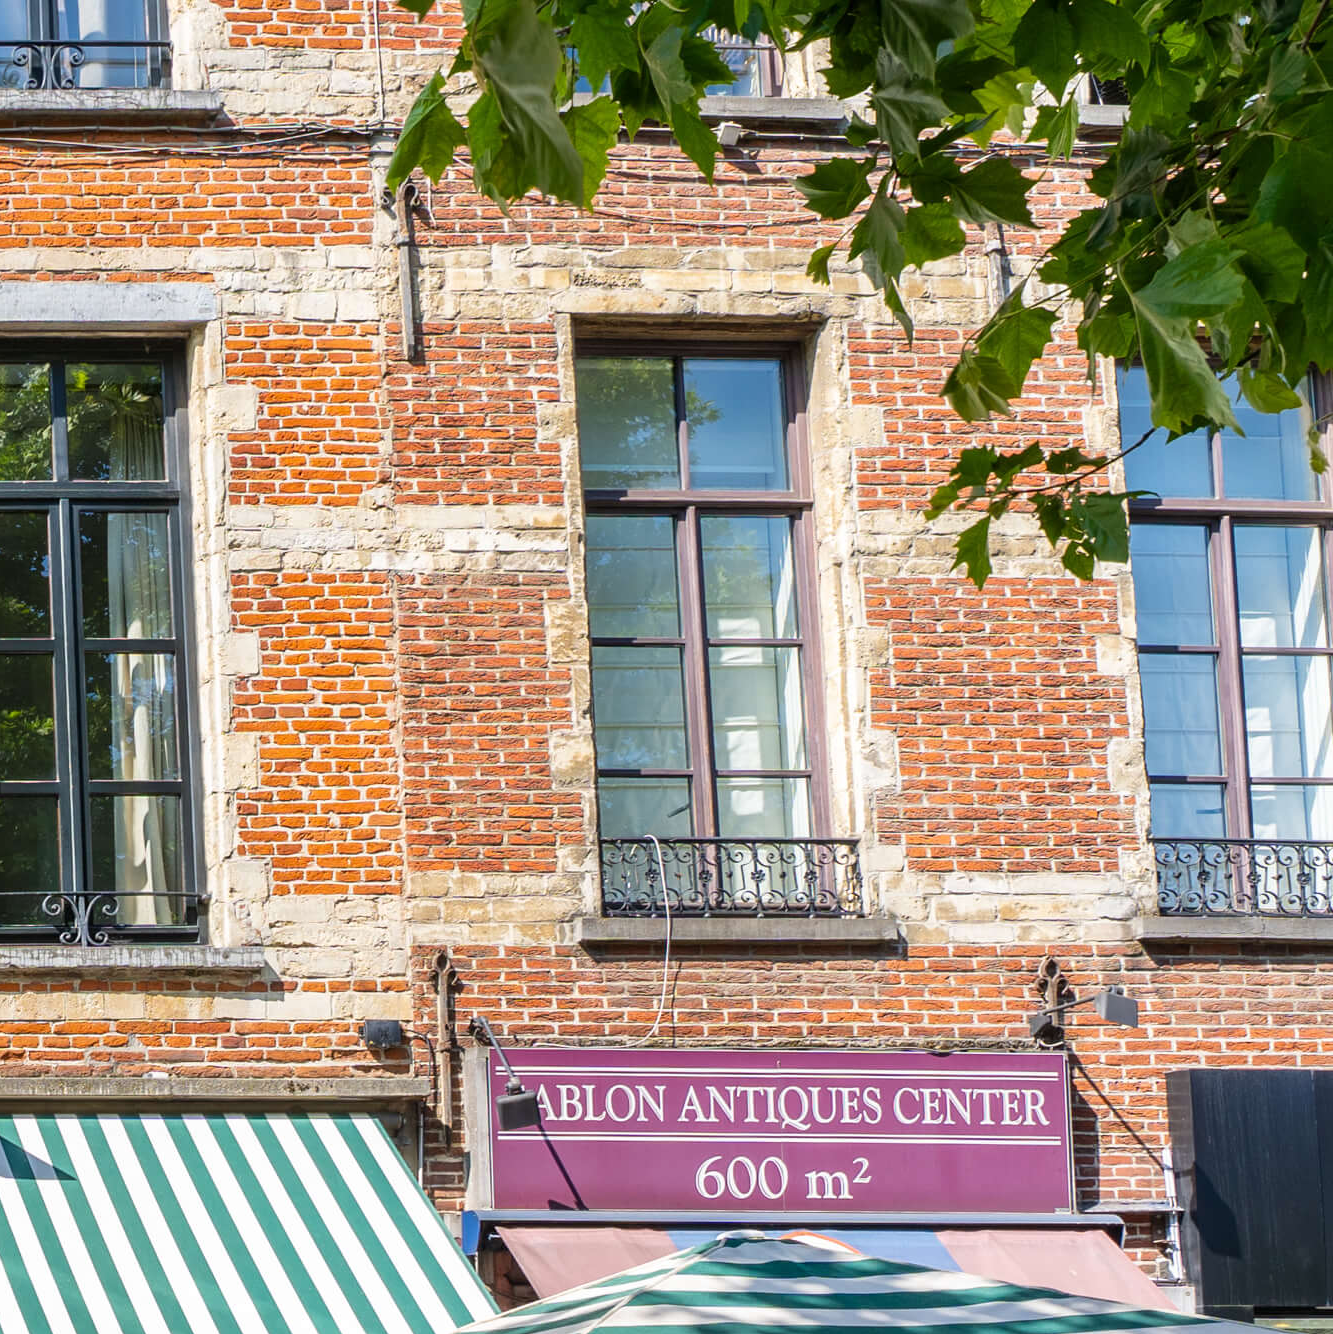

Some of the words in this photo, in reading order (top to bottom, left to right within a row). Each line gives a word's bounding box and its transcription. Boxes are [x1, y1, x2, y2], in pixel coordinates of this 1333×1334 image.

[522, 1084, 666, 1122] ABLON
[678, 1085, 881, 1131] ANTIQUES
[893, 1087, 1050, 1126] CENTER
[695, 1156, 788, 1200] 600
